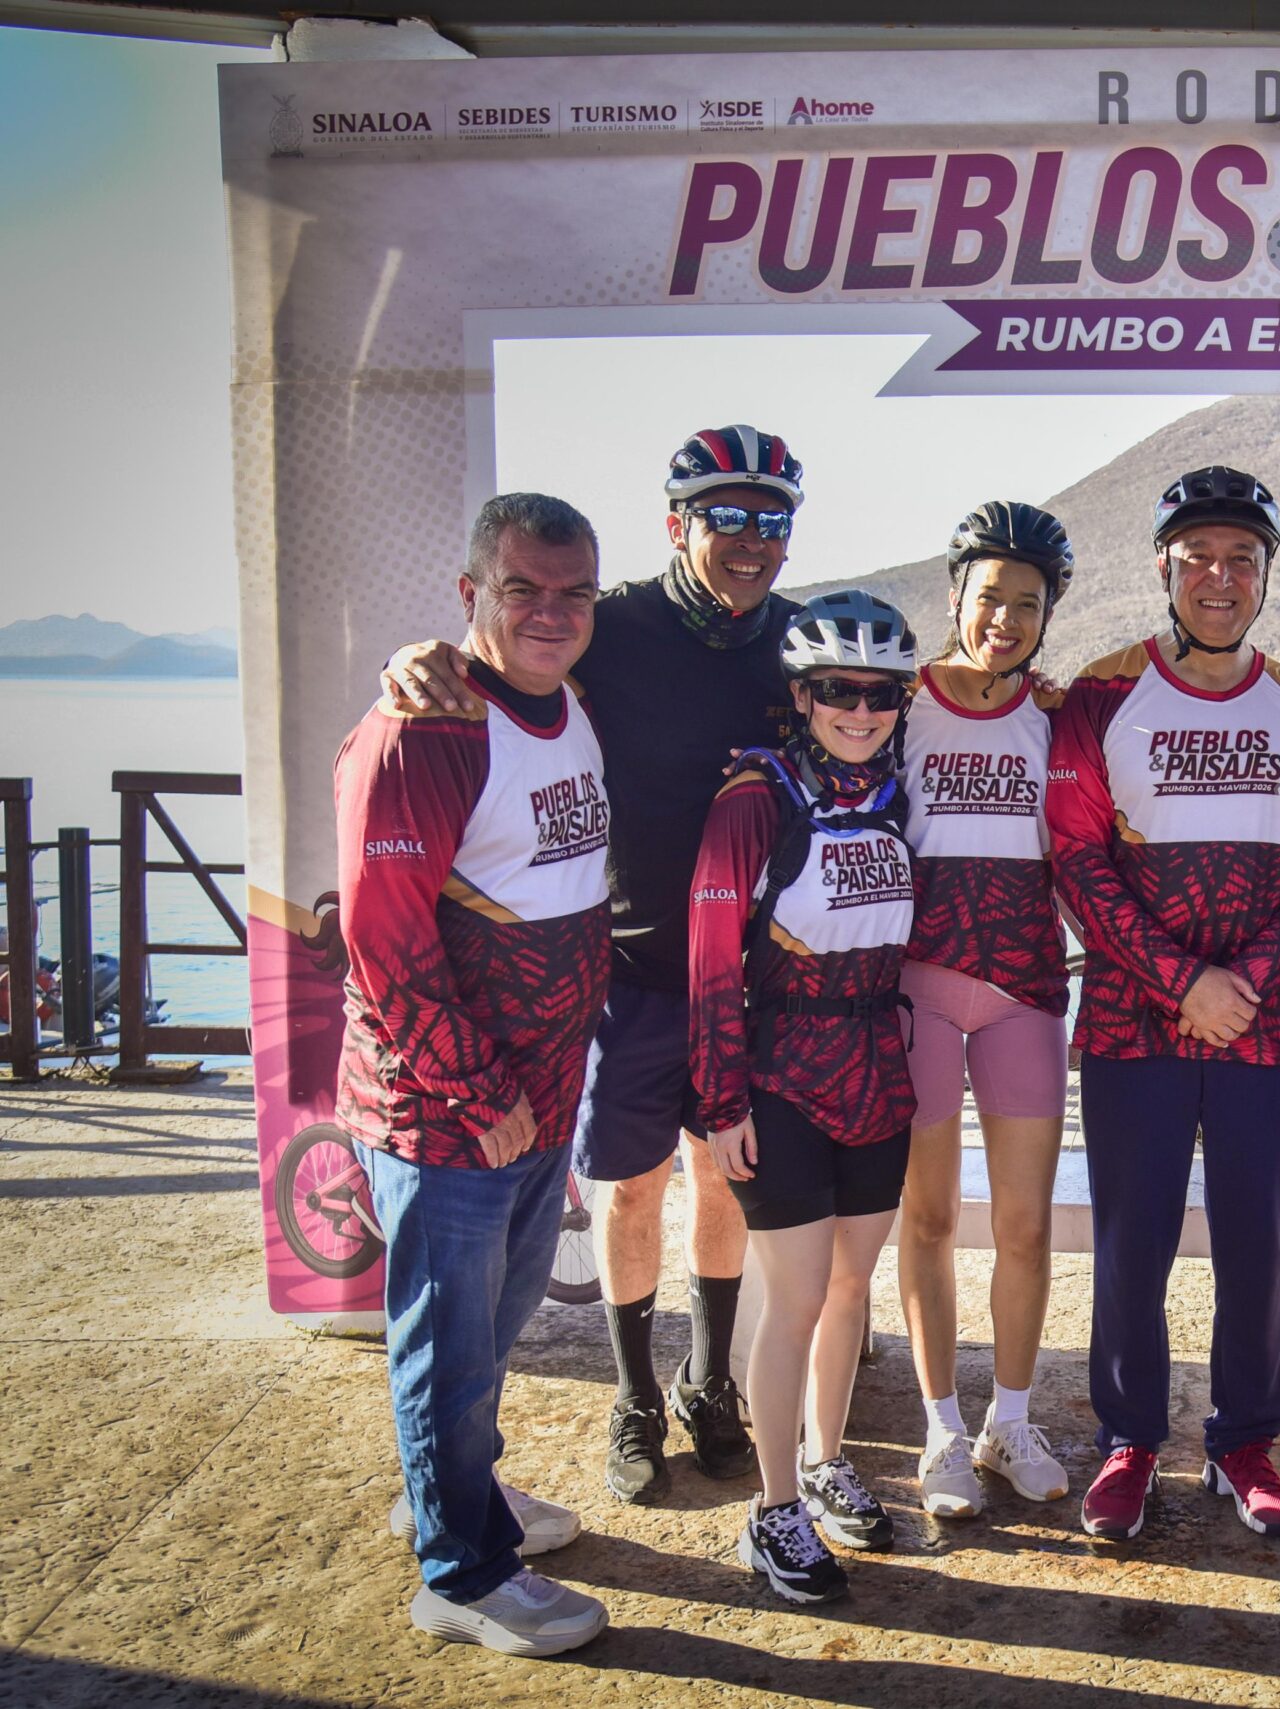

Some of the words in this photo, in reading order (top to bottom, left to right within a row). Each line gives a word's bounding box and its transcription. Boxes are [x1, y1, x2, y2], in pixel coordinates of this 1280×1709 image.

[458, 107, 551, 126] SEBIDES
[570, 105, 677, 123] TURISMO
[717, 101, 763, 117] ISDE
[787, 96, 874, 125] Ahome
[313, 112, 432, 134] SINALOA
[668, 144, 1268, 296] PUEBLOS
[996, 316, 1183, 353] RUMBO
[1195, 317, 1232, 353] A
[1148, 729, 1270, 756] PUEBLOS
[922, 753, 1027, 778] PUEBLOS
[1149, 754, 1165, 772] &
[529, 771, 599, 825] PUEBLOS
[921, 777, 935, 794] &
[934, 777, 1039, 804] PAISAJES
[1162, 785, 1195, 793] RUMBO
[1219, 783, 1251, 792] MAVIRI
[1252, 783, 1272, 791] 2026
[932, 805, 962, 813] RUMBO
[1012, 806, 1031, 814] 2026
[538, 822, 547, 845] &
[535, 851, 567, 862] RUMBO
[821, 838, 899, 869] PUEBLOS
[822, 869, 836, 886] &
[836, 862, 911, 895] PAISAJES
[835, 896, 862, 906] RUMBO
